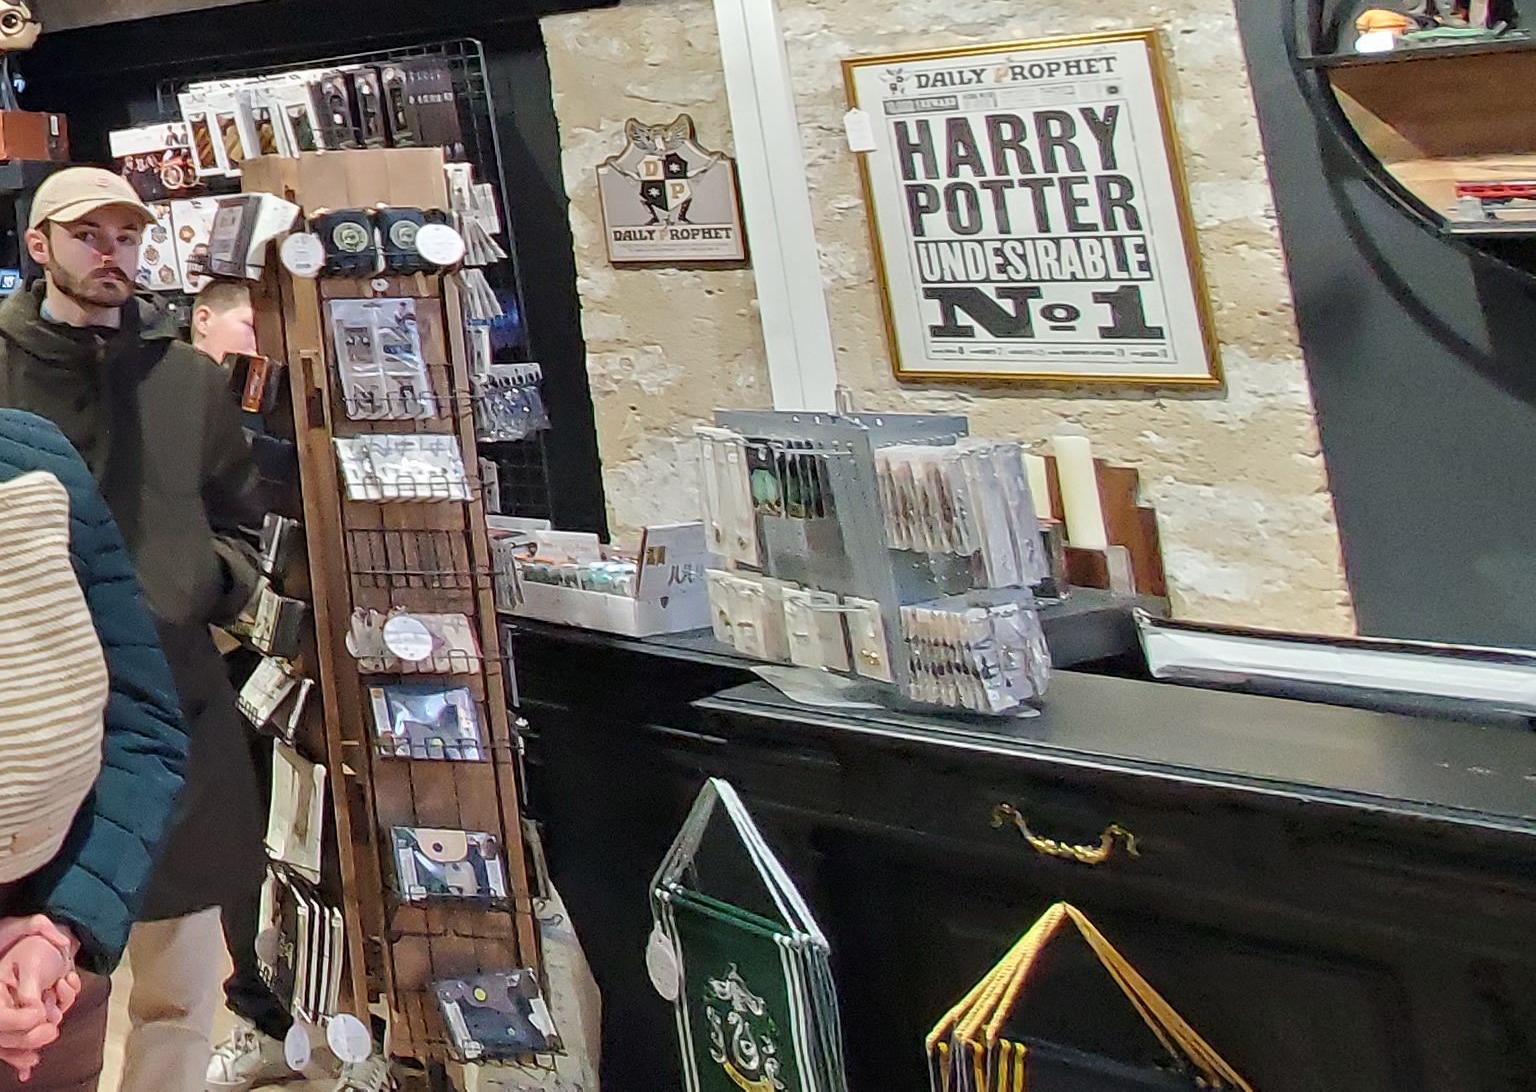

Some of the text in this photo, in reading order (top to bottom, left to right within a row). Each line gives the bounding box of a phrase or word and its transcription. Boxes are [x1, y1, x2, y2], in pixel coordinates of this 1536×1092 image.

[915, 56, 1117, 90] DAILY PROPHET
[893, 105, 1120, 181] HARRY
[644, 161, 658, 176] D
[670, 183, 685, 199] P
[903, 174, 1143, 237] POTTER
[613, 227, 732, 242] DAILY PROPHET
[918, 237, 1151, 282] UNDESIRABLE
